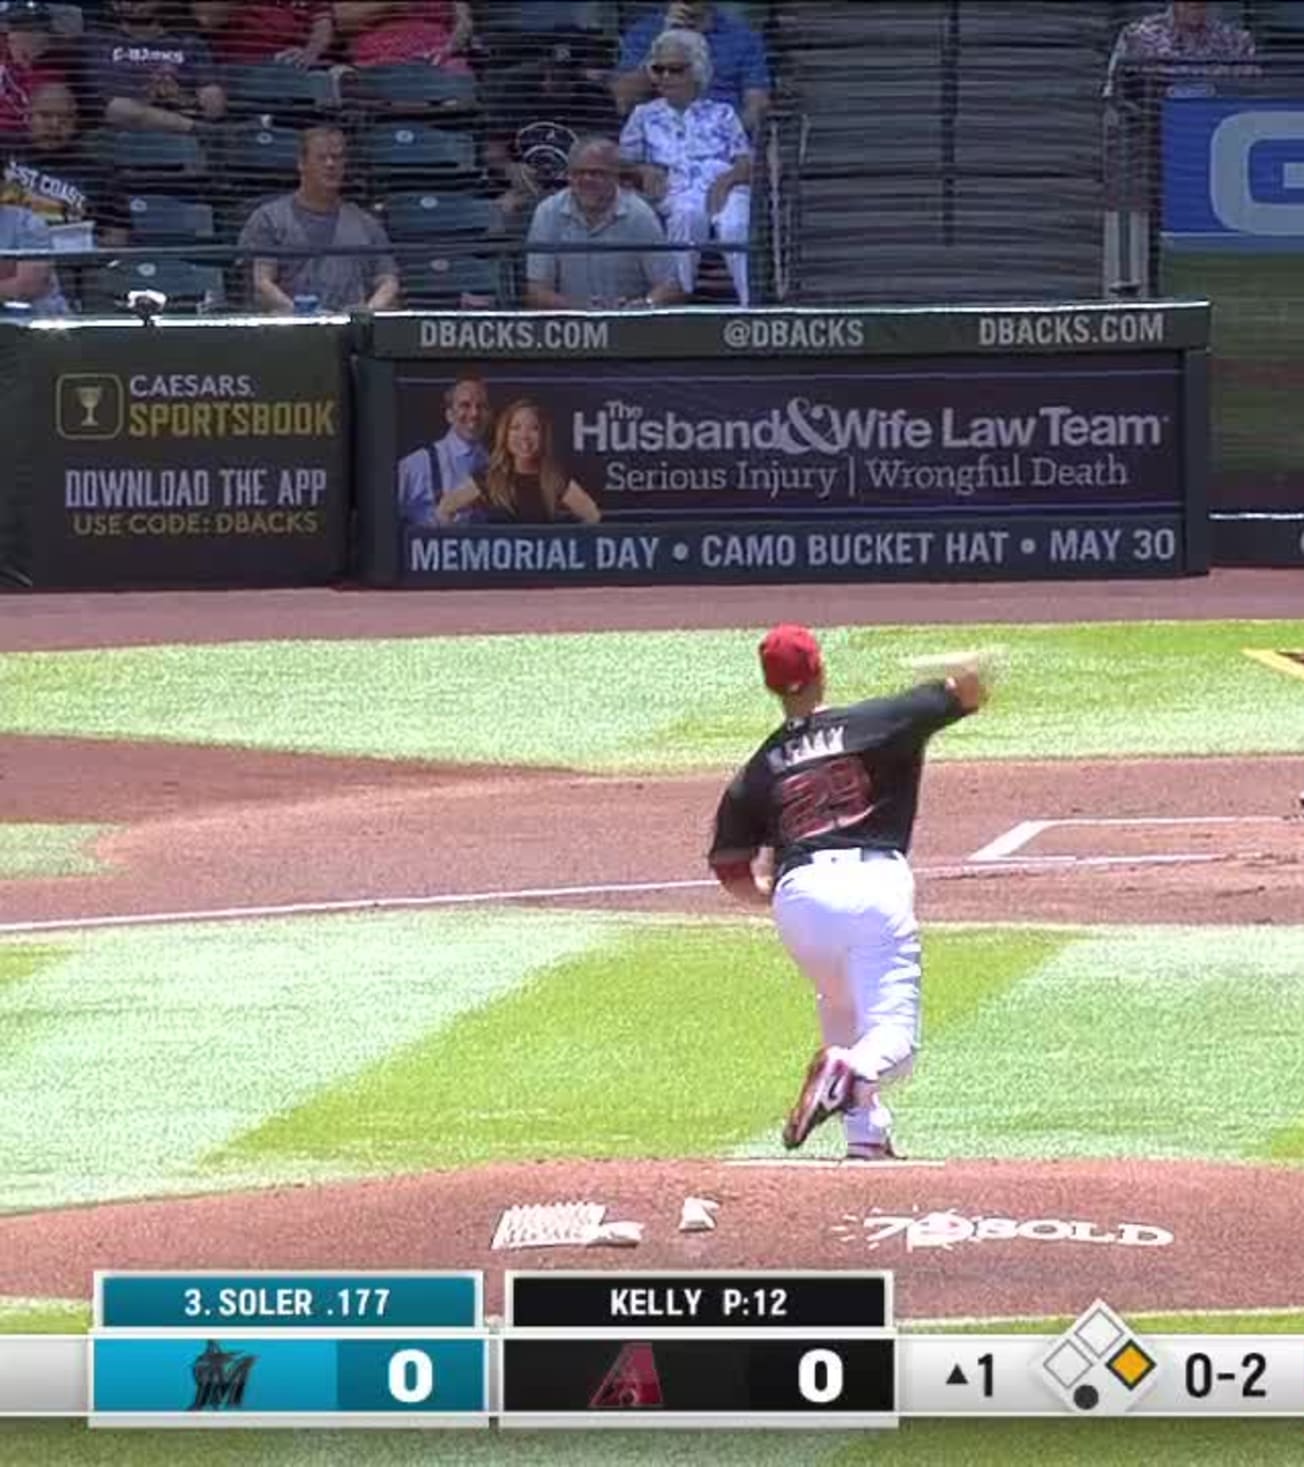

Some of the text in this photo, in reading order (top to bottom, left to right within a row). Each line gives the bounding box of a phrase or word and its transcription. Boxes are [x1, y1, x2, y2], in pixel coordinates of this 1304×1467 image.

[420, 320, 608, 349] DBACKS.COM
[723, 319, 864, 348] @DBACKS
[980, 314, 1164, 345] DBACKS.COM
[129, 374, 252, 398] CAESARS
[129, 401, 337, 438] SPORTSBOOK
[606, 401, 643, 420] The
[942, 408, 1037, 448] Law
[1039, 407, 1161, 446] Team
[65, 469, 327, 507] DOWNLOAD THE APP
[605, 454, 1129, 499] Serious Injury Wrongful Death
[73, 511, 318, 536] USE CODE: DBACKS
[411, 529, 1176, 571] MEMORIAL DAY CAMO BUCKET HAT MAY 30
